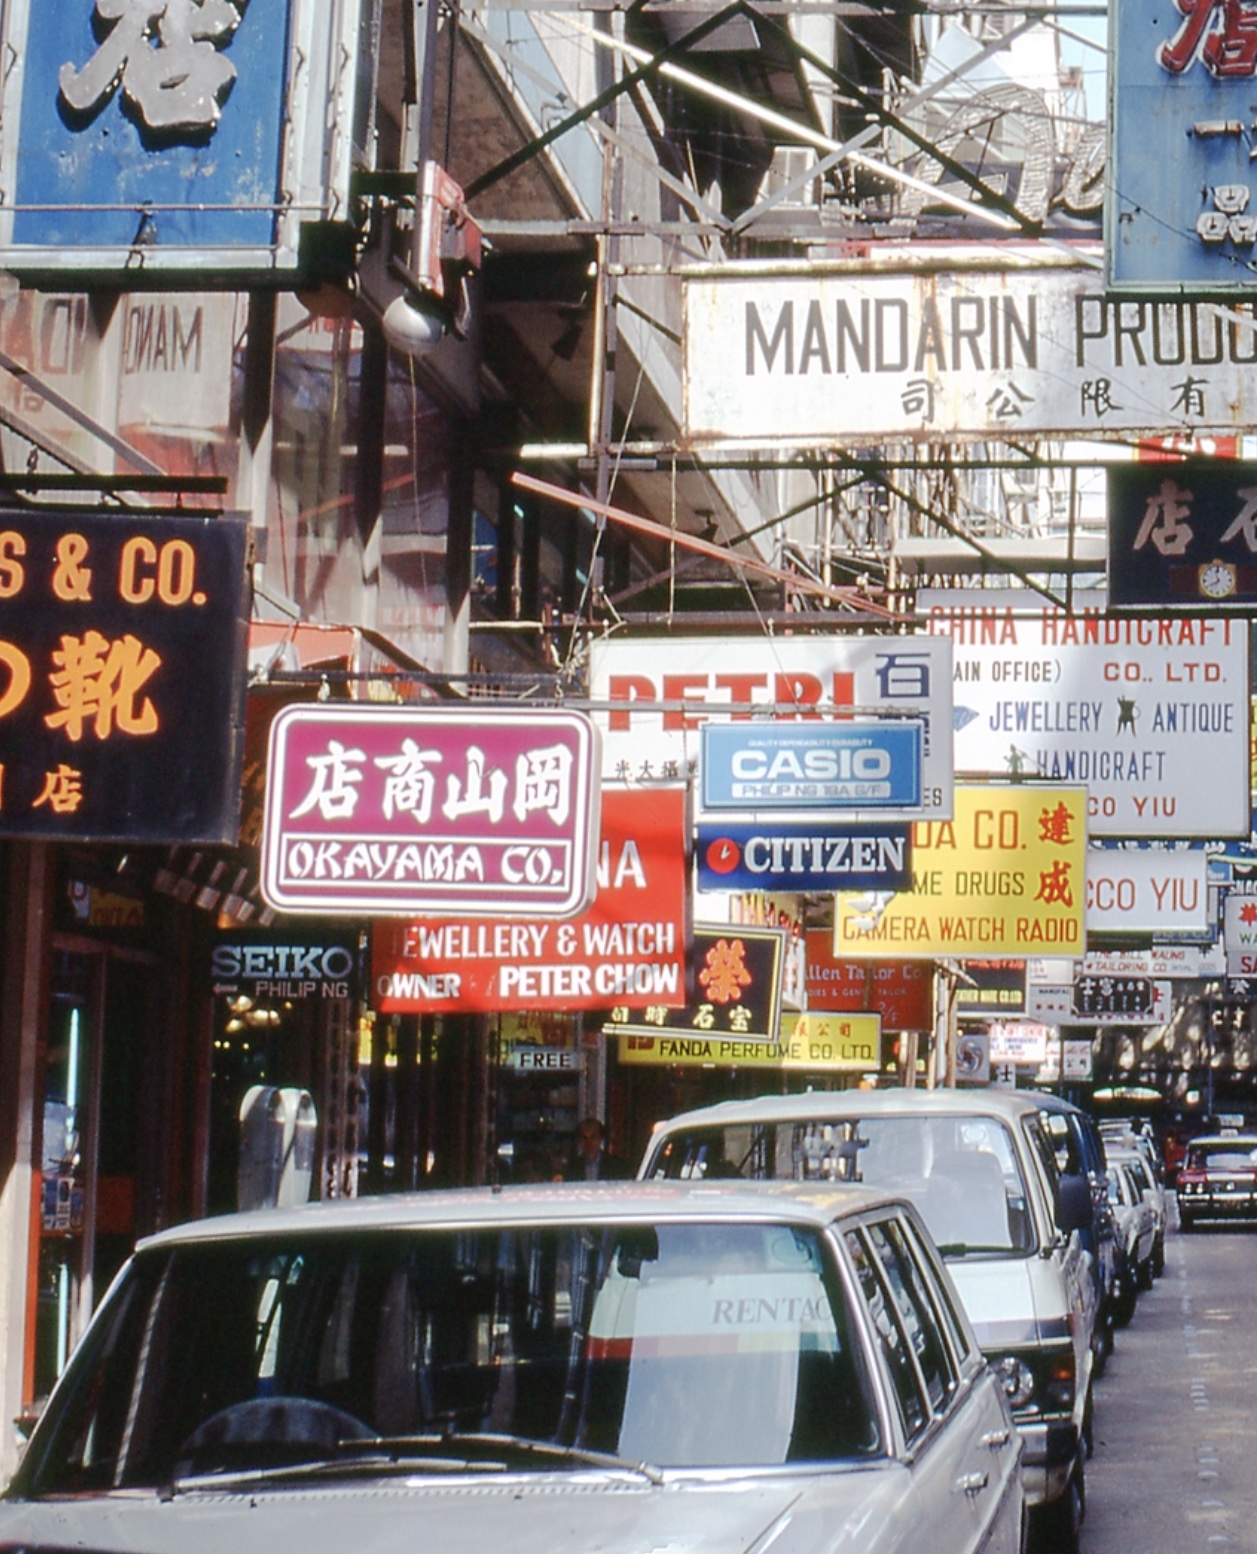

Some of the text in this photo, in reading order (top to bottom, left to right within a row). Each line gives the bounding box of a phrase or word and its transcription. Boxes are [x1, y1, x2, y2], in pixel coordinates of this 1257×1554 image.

[744, 296, 1039, 377] MANDARIN
[53, 533, 92, 601] &
[120, 536, 207, 606] CO.
[927, 604, 1232, 646] CHINA HANDICRAFT
[992, 660, 1062, 683] OFFICE)
[1166, 662, 1228, 683] LTD.
[609, 672, 855, 731] PETRI
[989, 701, 1233, 732] JEWELLERY ANTIQUE
[731, 748, 891, 780] CASIO
[1037, 751, 1166, 781] HANDICRAFT
[742, 784, 791, 797] PHILIP
[795, 784, 818, 797] NG
[1136, 796, 1177, 817] YIU
[974, 811, 1027, 850] CO.
[288, 843, 485, 883] OKAYAMA
[744, 837, 905, 873] CITIZEN
[955, 871, 1025, 897] DRUGS
[1151, 878, 1199, 911] YIU
[557, 924, 577, 957] &
[582, 923, 675, 957] WATCH
[842, 916, 1078, 942] CAMERA WATCH RADIO
[211, 945, 354, 980] SEIKO
[846, 963, 895, 980] Talor
[255, 981, 348, 999] PHILIP NG
[378, 962, 679, 999] OWNER PETER CHOW
[520, 1053, 571, 1068] FREE
[660, 1041, 712, 1056] FANDA
[719, 1041, 801, 1059] PERFUME
[810, 1043, 836, 1059] CO.
[842, 1043, 874, 1060] LTD.
